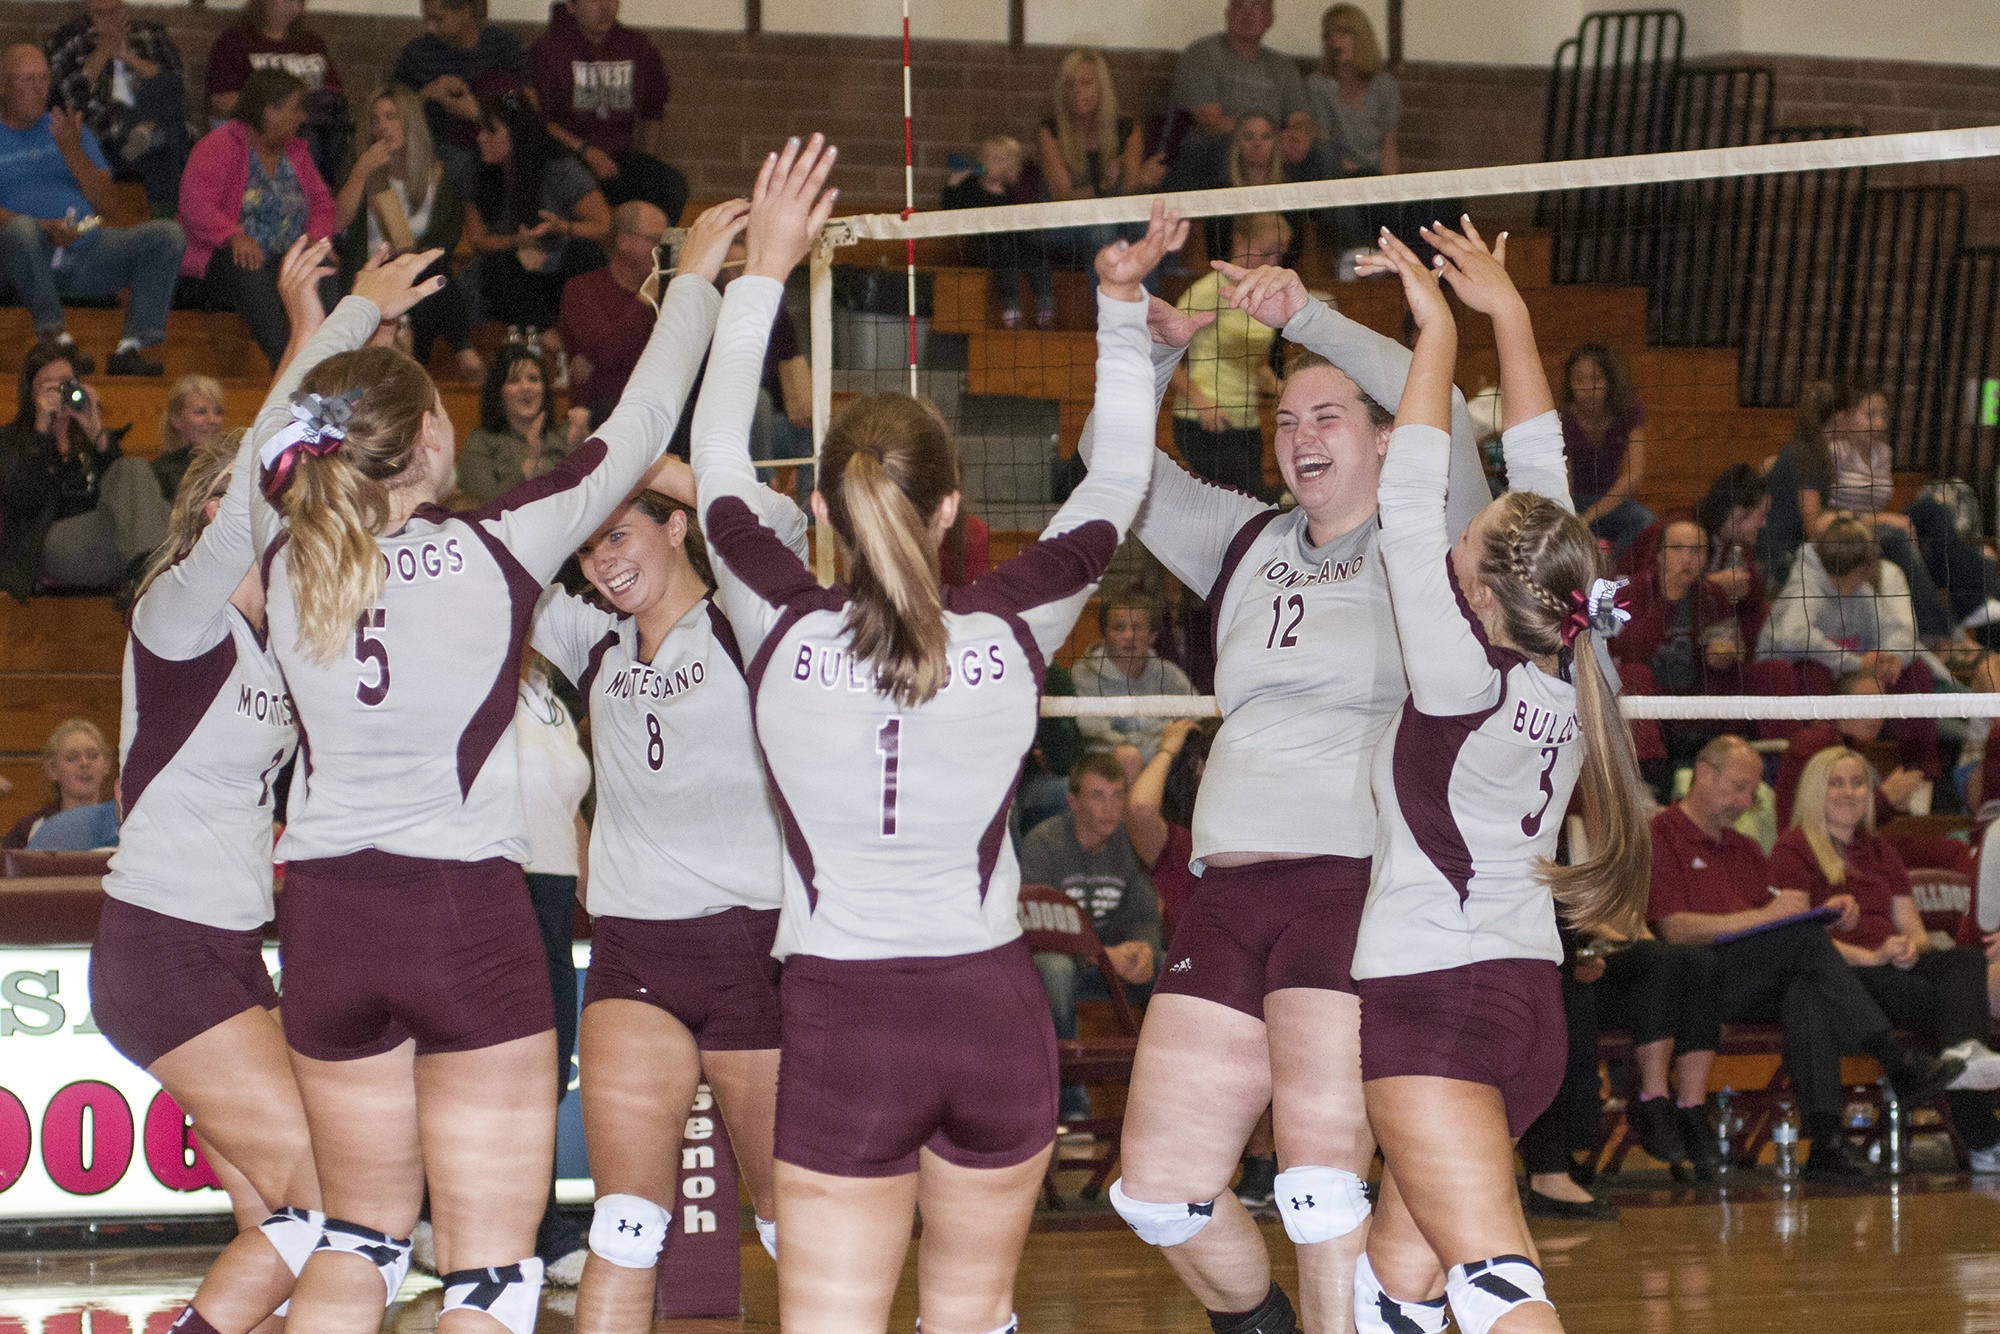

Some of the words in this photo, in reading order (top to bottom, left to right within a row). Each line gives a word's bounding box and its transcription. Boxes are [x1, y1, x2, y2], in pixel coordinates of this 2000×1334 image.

[354, 607, 391, 708] 5
[1266, 593, 1305, 650] 12
[645, 711, 665, 773] 8
[877, 717, 901, 838] 1
[1520, 746, 1559, 838] 3
